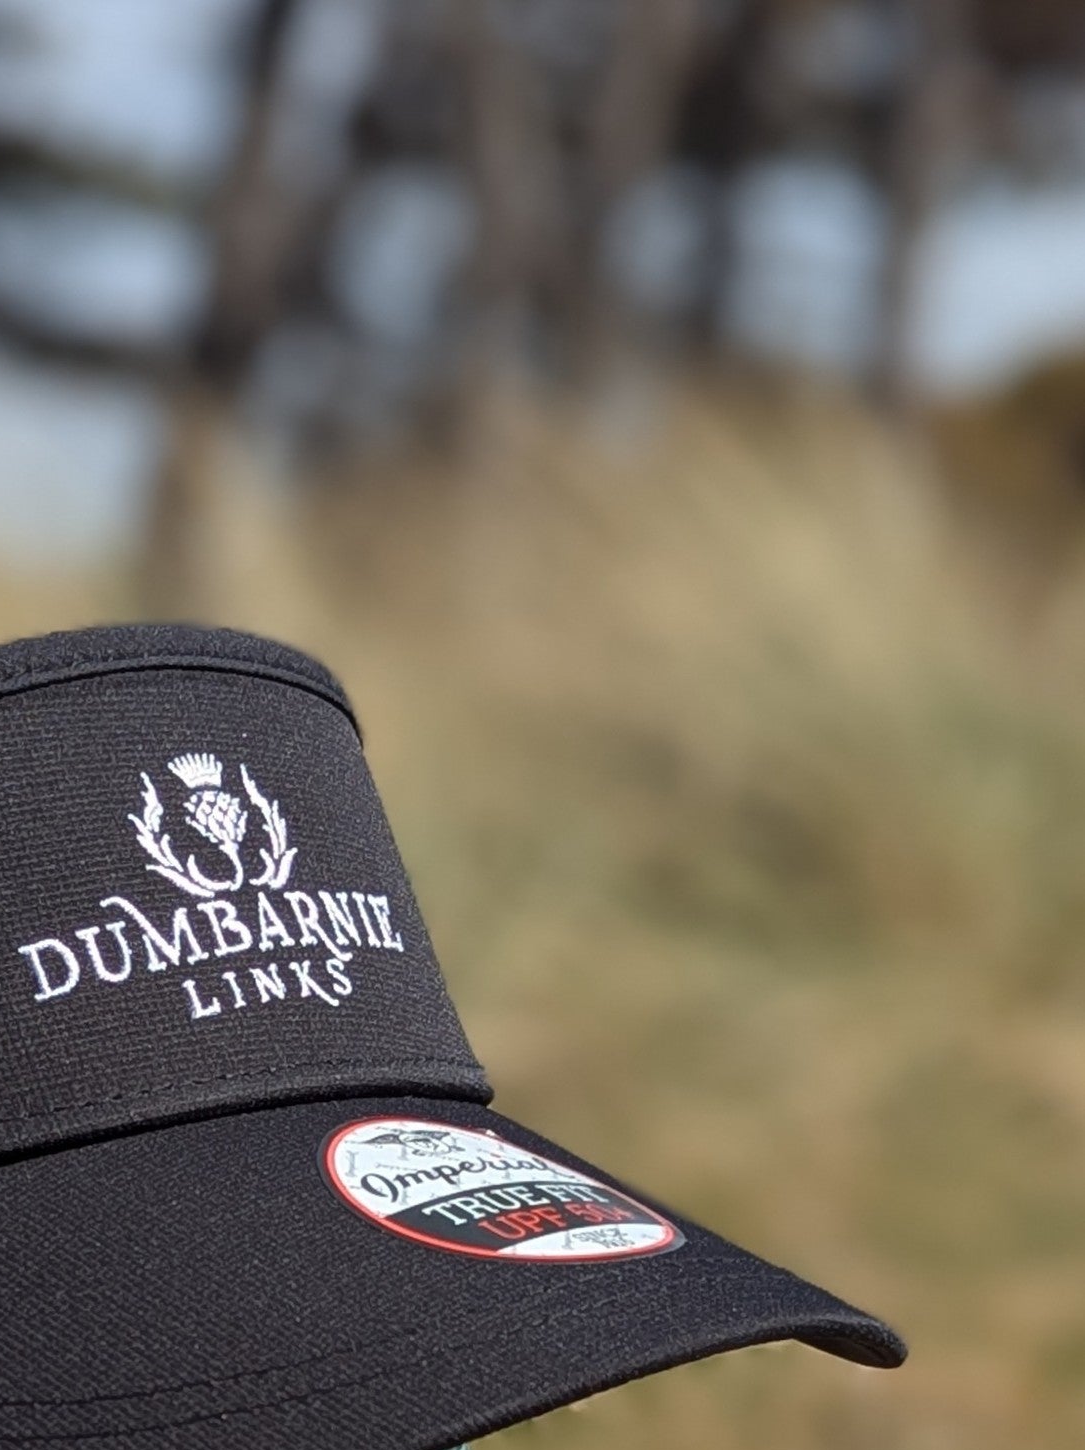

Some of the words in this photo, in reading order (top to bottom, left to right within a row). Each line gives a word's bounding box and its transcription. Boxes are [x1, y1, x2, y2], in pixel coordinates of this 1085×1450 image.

[18, 890, 404, 1001] DUMBARNIE
[182, 958, 353, 1019] LINKS
[421, 1185, 551, 1226] TRUE
[534, 1183, 609, 1203] FIT
[478, 1206, 567, 1240] UPF
